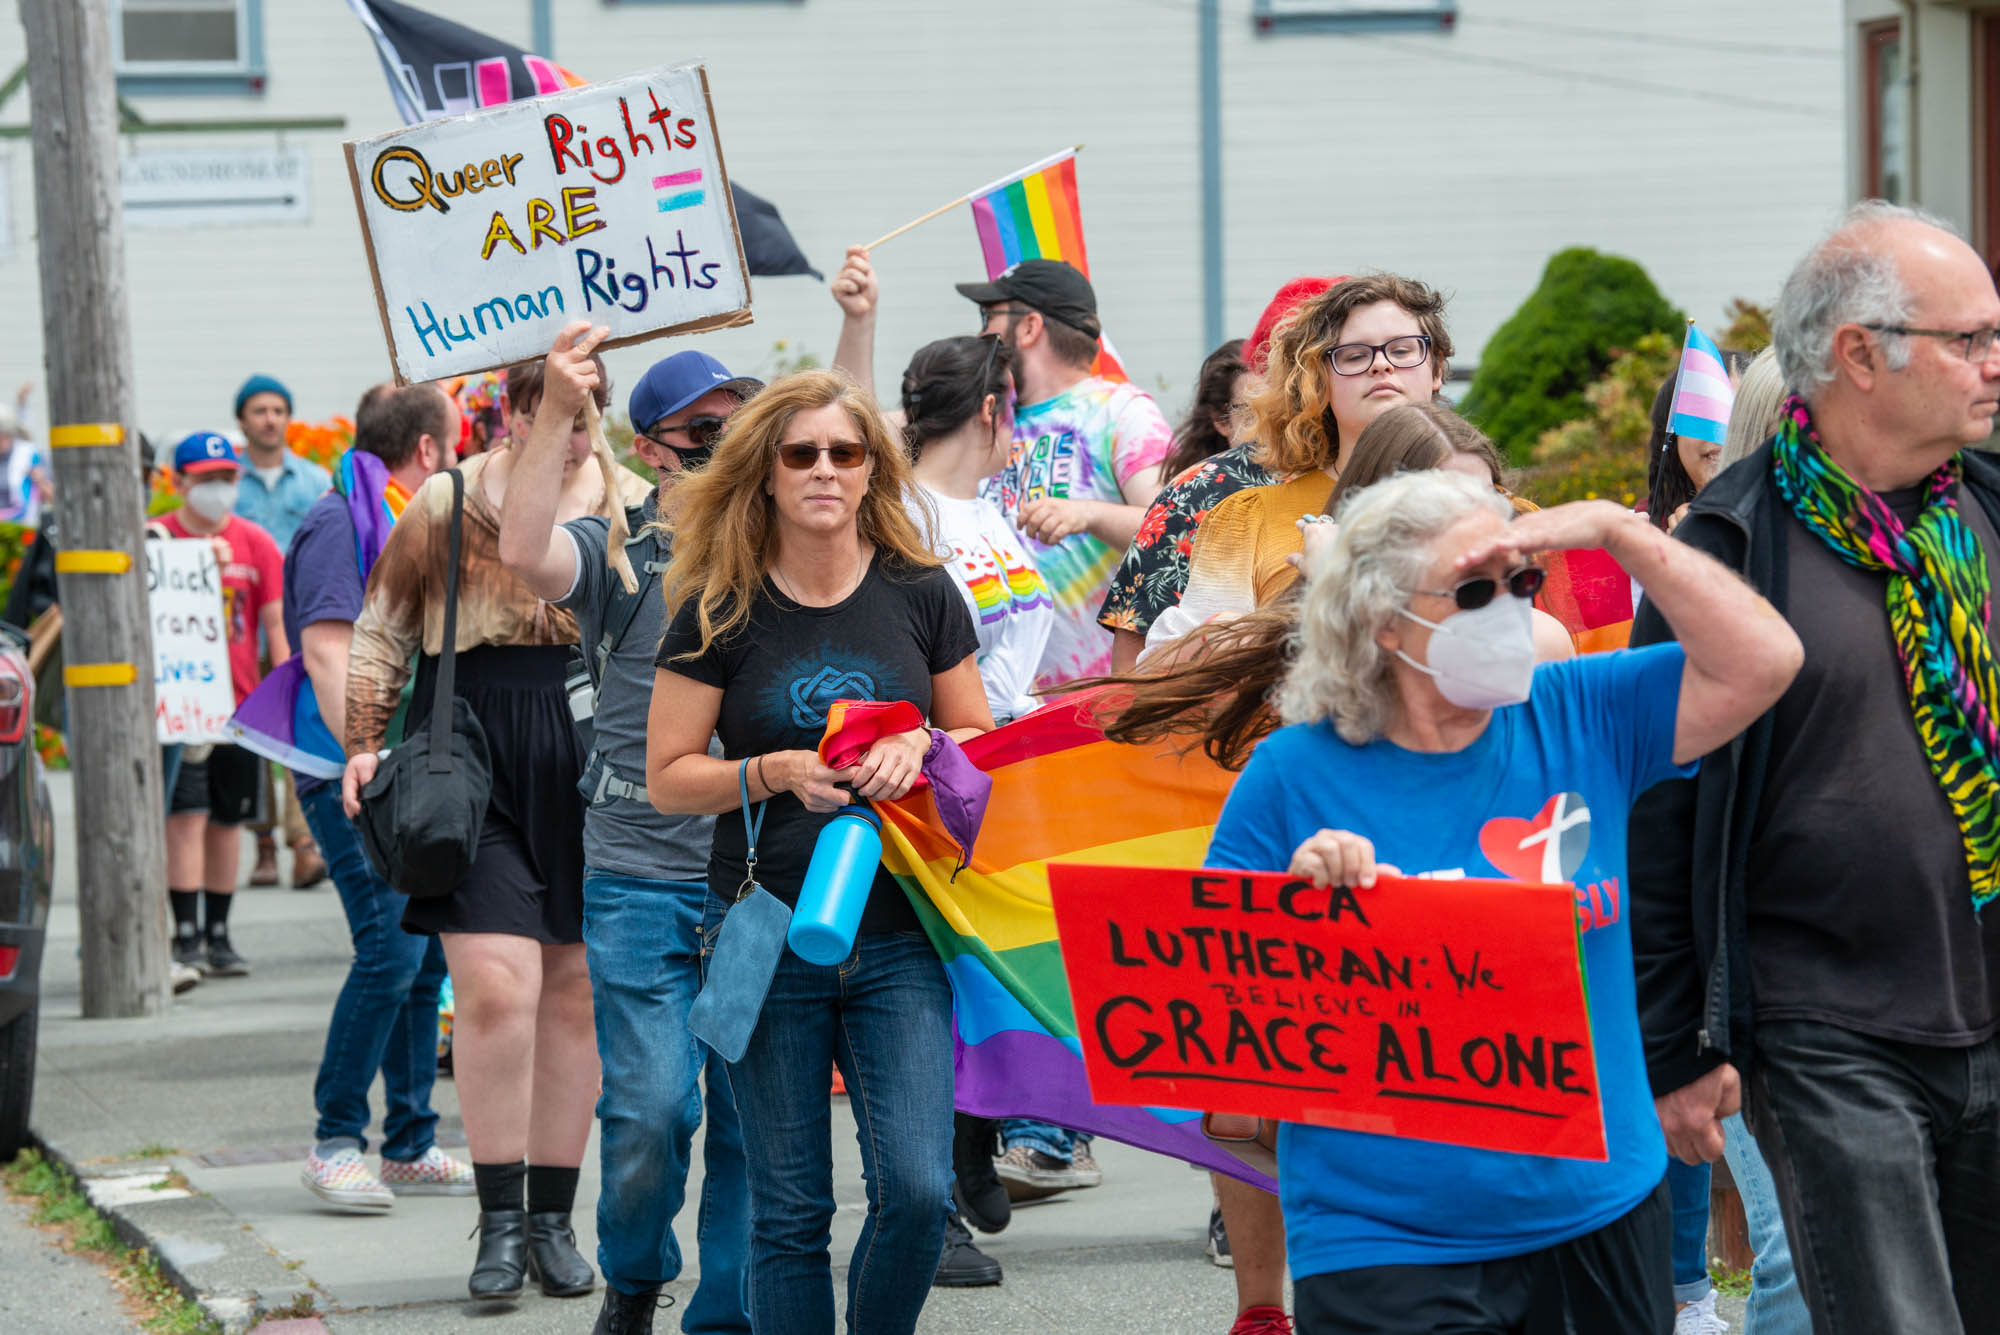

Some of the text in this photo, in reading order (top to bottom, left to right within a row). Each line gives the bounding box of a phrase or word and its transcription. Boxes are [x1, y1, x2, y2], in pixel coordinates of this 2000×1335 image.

[371, 86, 697, 215] Queer Rights
[480, 186, 608, 261] ARE
[405, 230, 721, 357] Human Rights
[156, 613, 219, 641] rans
[1191, 876, 1371, 928] ELCA
[1108, 918, 1504, 998] LUTHERAN: We
[1208, 983, 1421, 1018] BELIEVE IN
[1095, 994, 1591, 1097] GRACE ALONE
